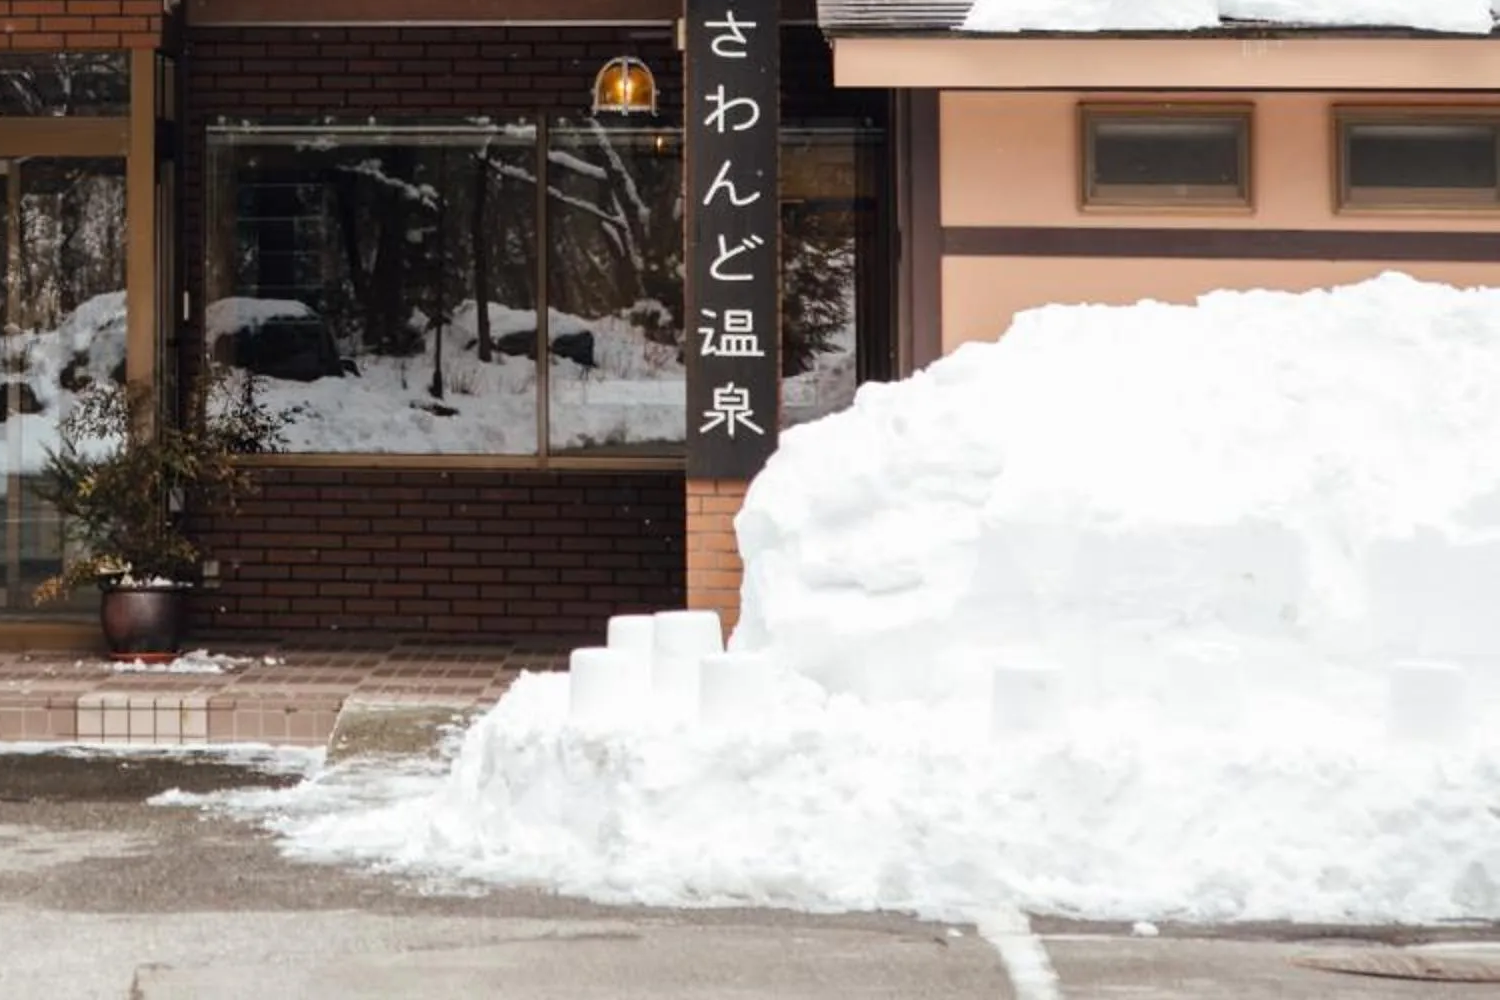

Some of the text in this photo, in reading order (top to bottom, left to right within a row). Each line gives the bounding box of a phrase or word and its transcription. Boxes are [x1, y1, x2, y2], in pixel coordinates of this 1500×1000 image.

[698, 10, 765, 436] さわんど温泉
